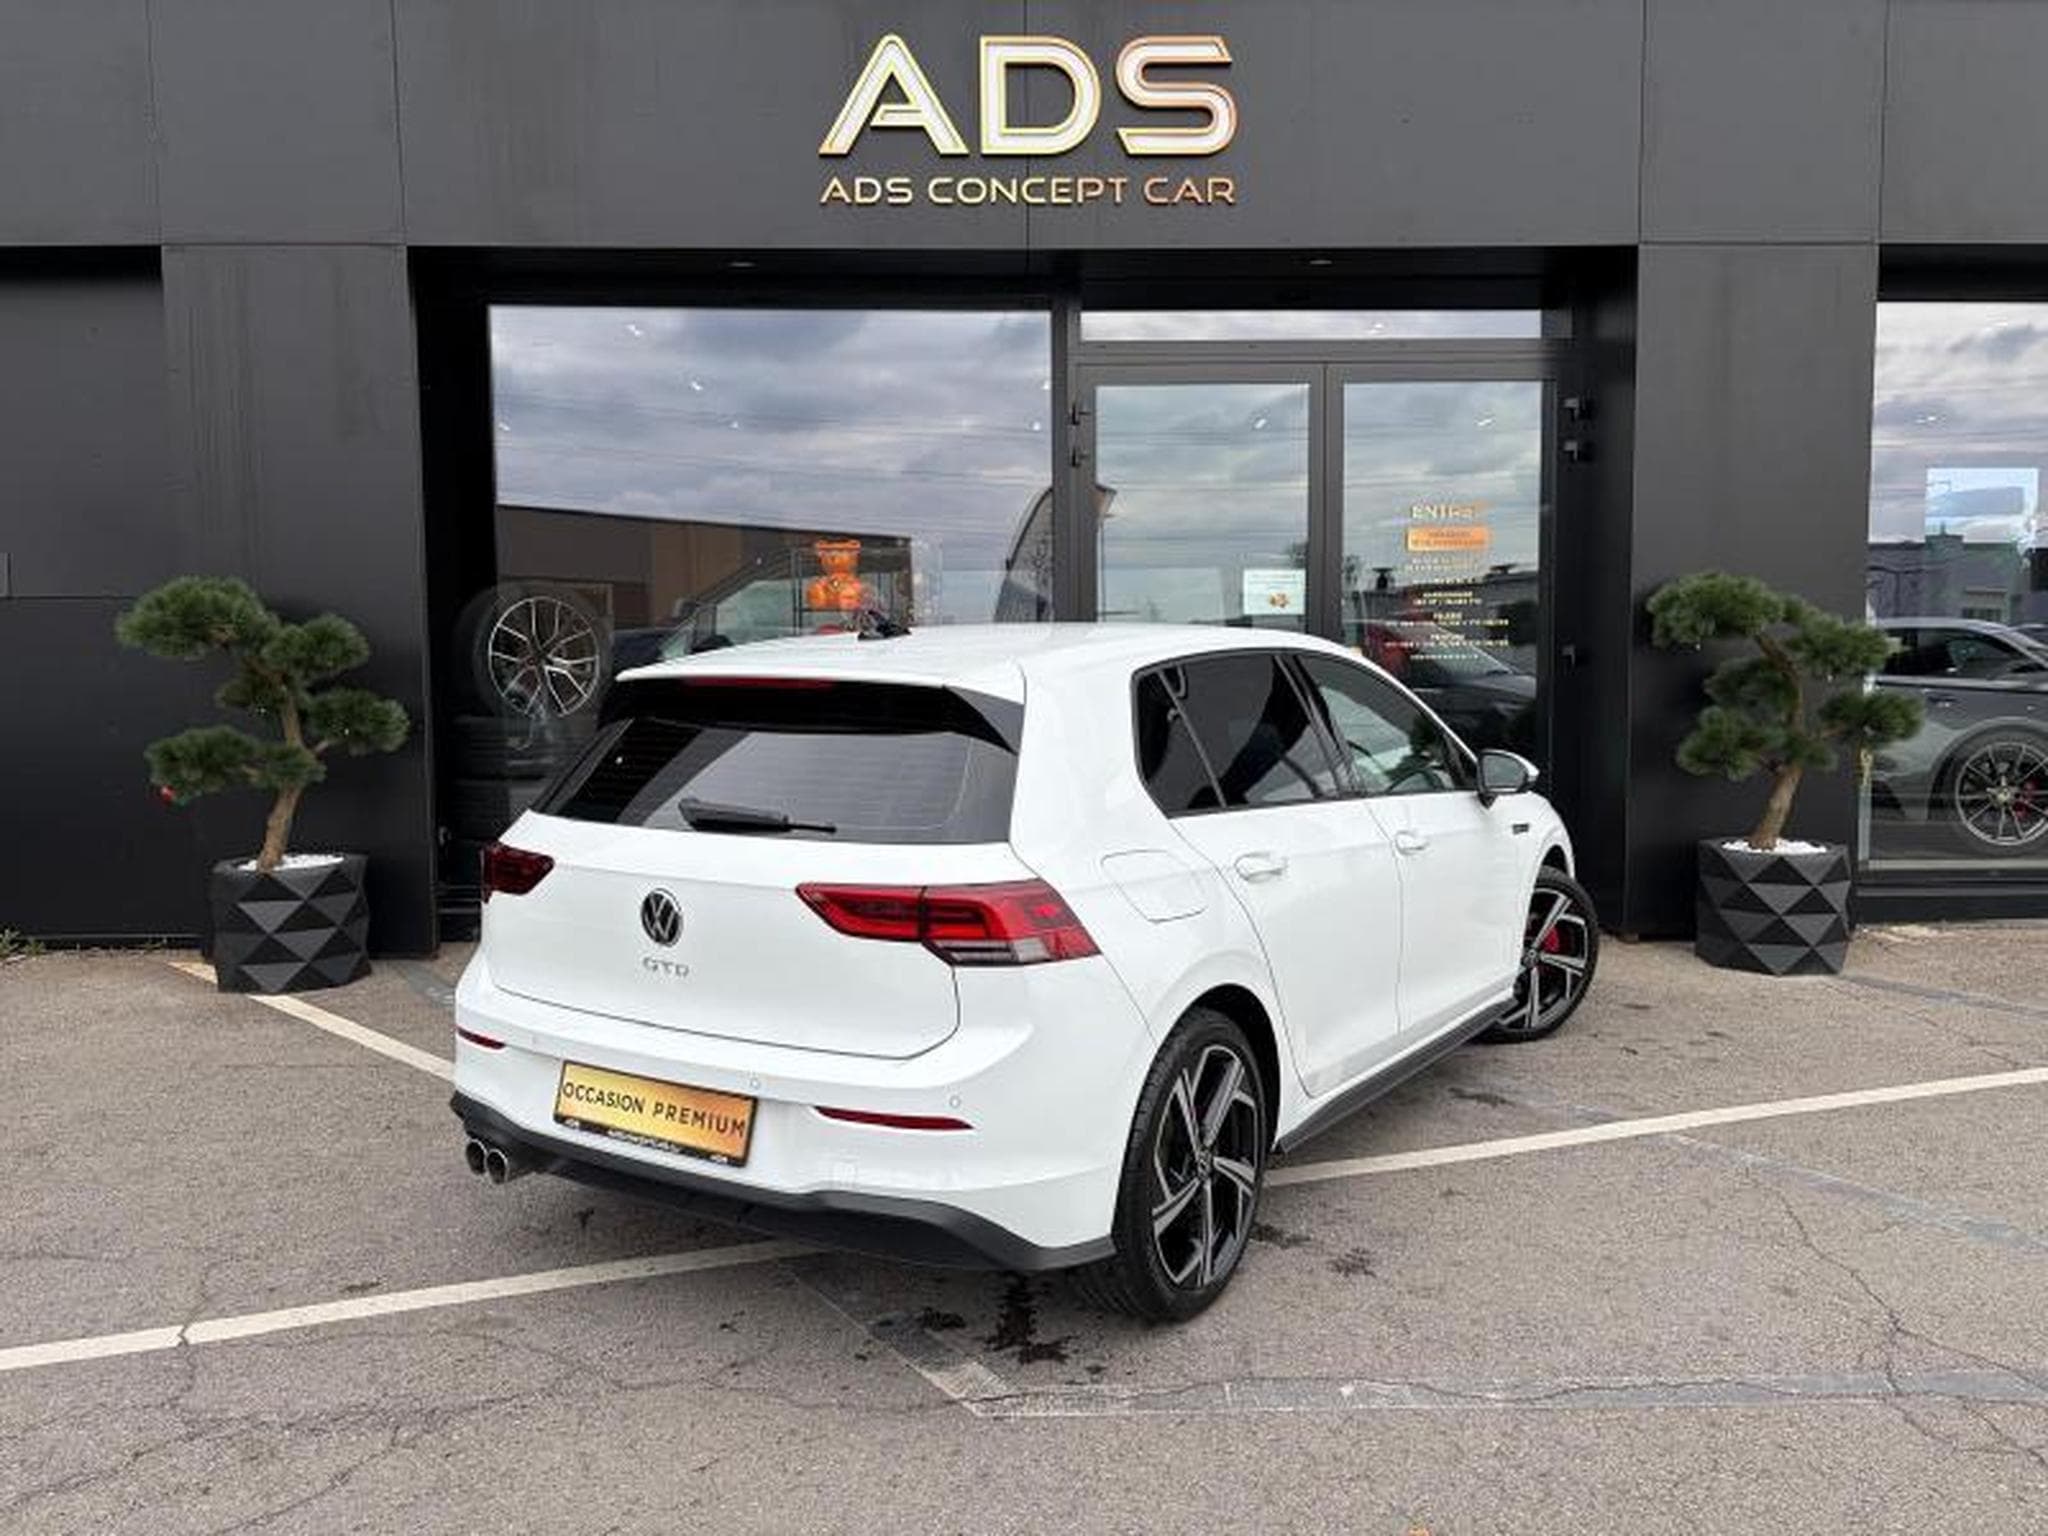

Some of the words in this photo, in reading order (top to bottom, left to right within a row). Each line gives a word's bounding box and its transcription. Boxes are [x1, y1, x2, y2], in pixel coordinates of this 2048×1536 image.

[818, 32, 1238, 156] ADS
[819, 177, 914, 205] ADS
[927, 177, 1129, 205] CONCEPT
[1143, 177, 1236, 205] CAR
[643, 956, 690, 978] GTD
[561, 1081, 646, 1115] OCCASION
[653, 1102, 746, 1138] PREMIUM
